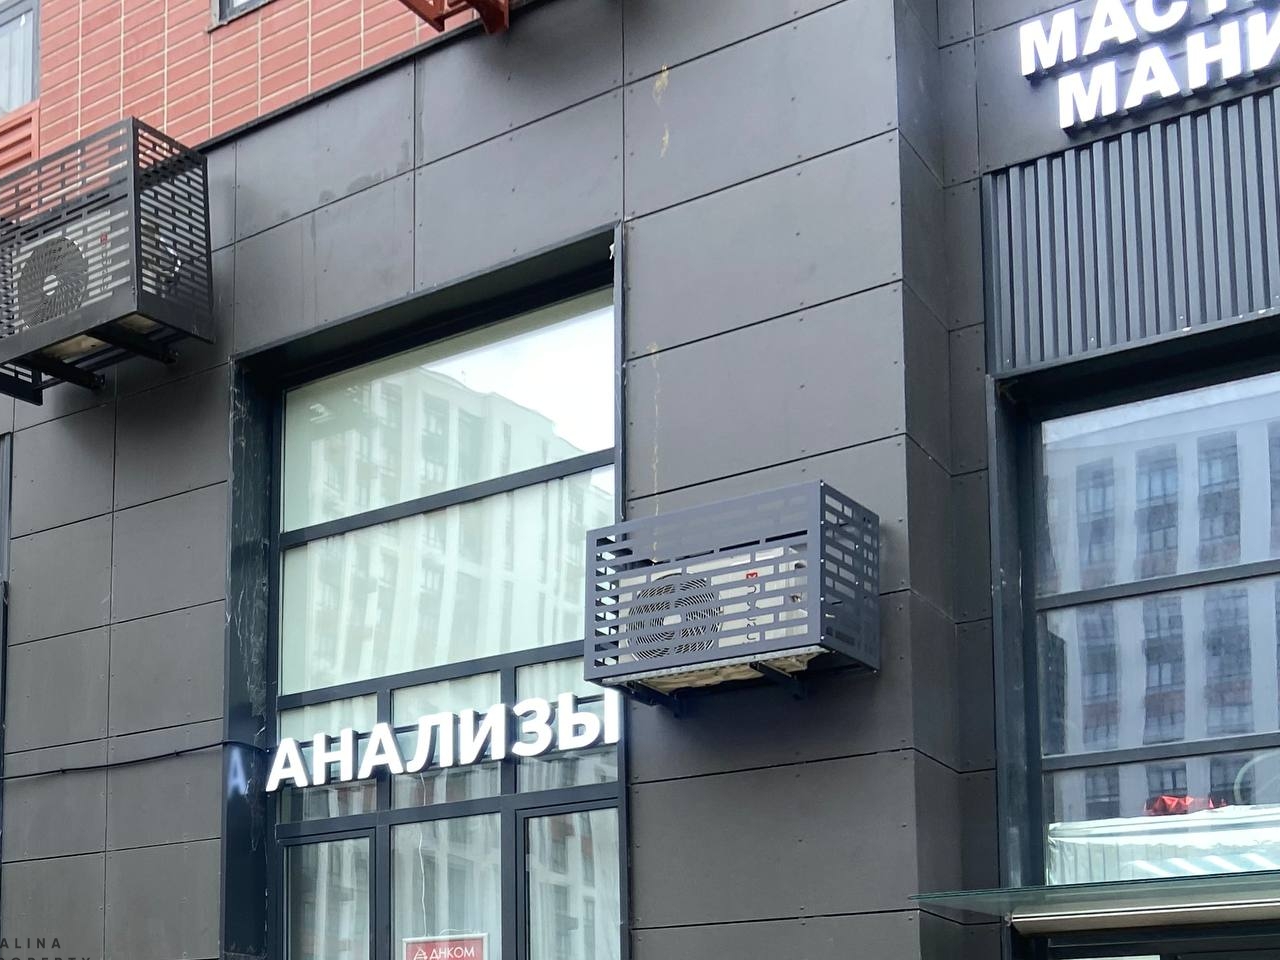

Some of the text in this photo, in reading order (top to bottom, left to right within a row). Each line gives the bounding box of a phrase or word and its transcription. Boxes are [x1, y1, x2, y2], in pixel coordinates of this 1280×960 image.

[1019, 0, 1227, 76] МАС
[265, 687, 621, 792] АНАЛИЗЫ
[429, 946, 475, 960] ДНКОМ
